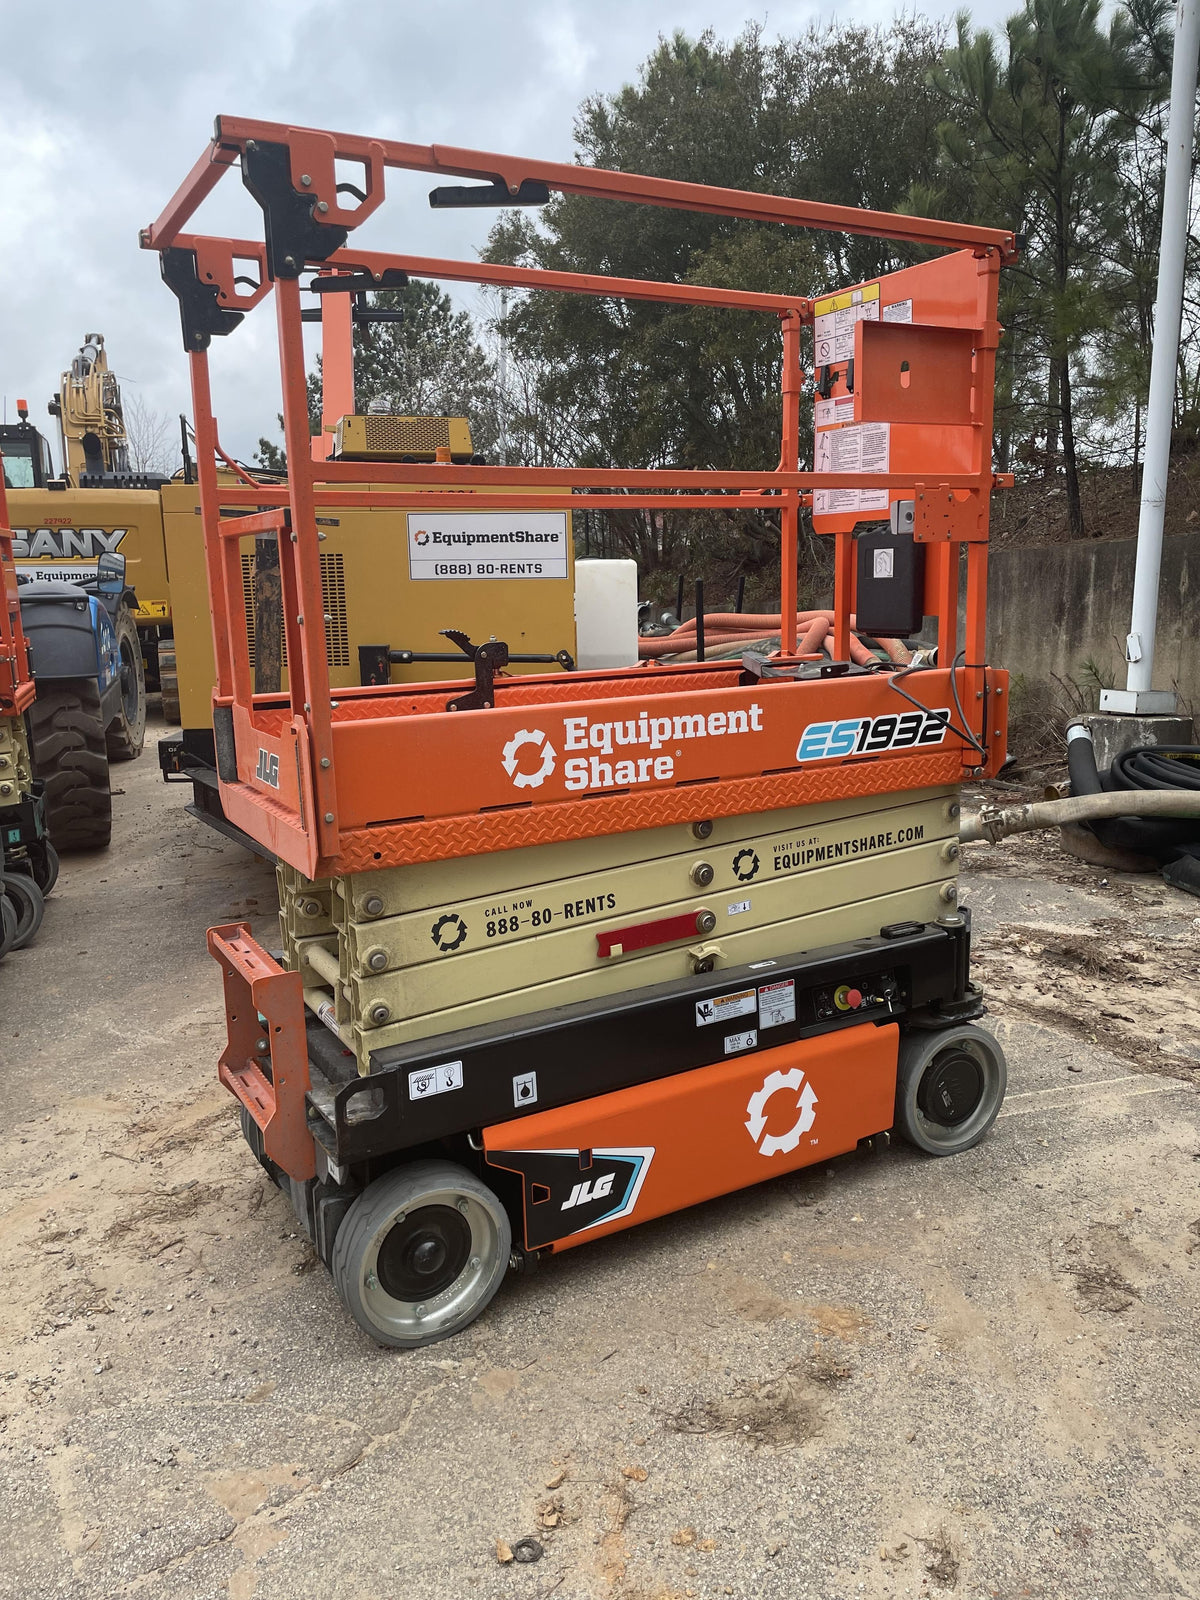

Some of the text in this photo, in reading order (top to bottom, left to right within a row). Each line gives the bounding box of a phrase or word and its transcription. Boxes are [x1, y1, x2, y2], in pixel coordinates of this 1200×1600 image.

[11, 528, 128, 557] SANY
[432, 531, 559, 546] EquipmentShare
[434, 563, 543, 575] (888) 80-RENTS
[563, 703, 763, 755] Equipment
[797, 708, 951, 762] ES1932
[256, 748, 280, 790] JLG
[564, 755, 674, 791] Share
[773, 837, 820, 853] VISIT US AT:
[774, 825, 924, 871] EQUIPMENTSHARE.COM
[484, 899, 533, 918] CALL NOW
[486, 893, 616, 938] 888-80-RENTS
[560, 1172, 616, 1211] JLG
